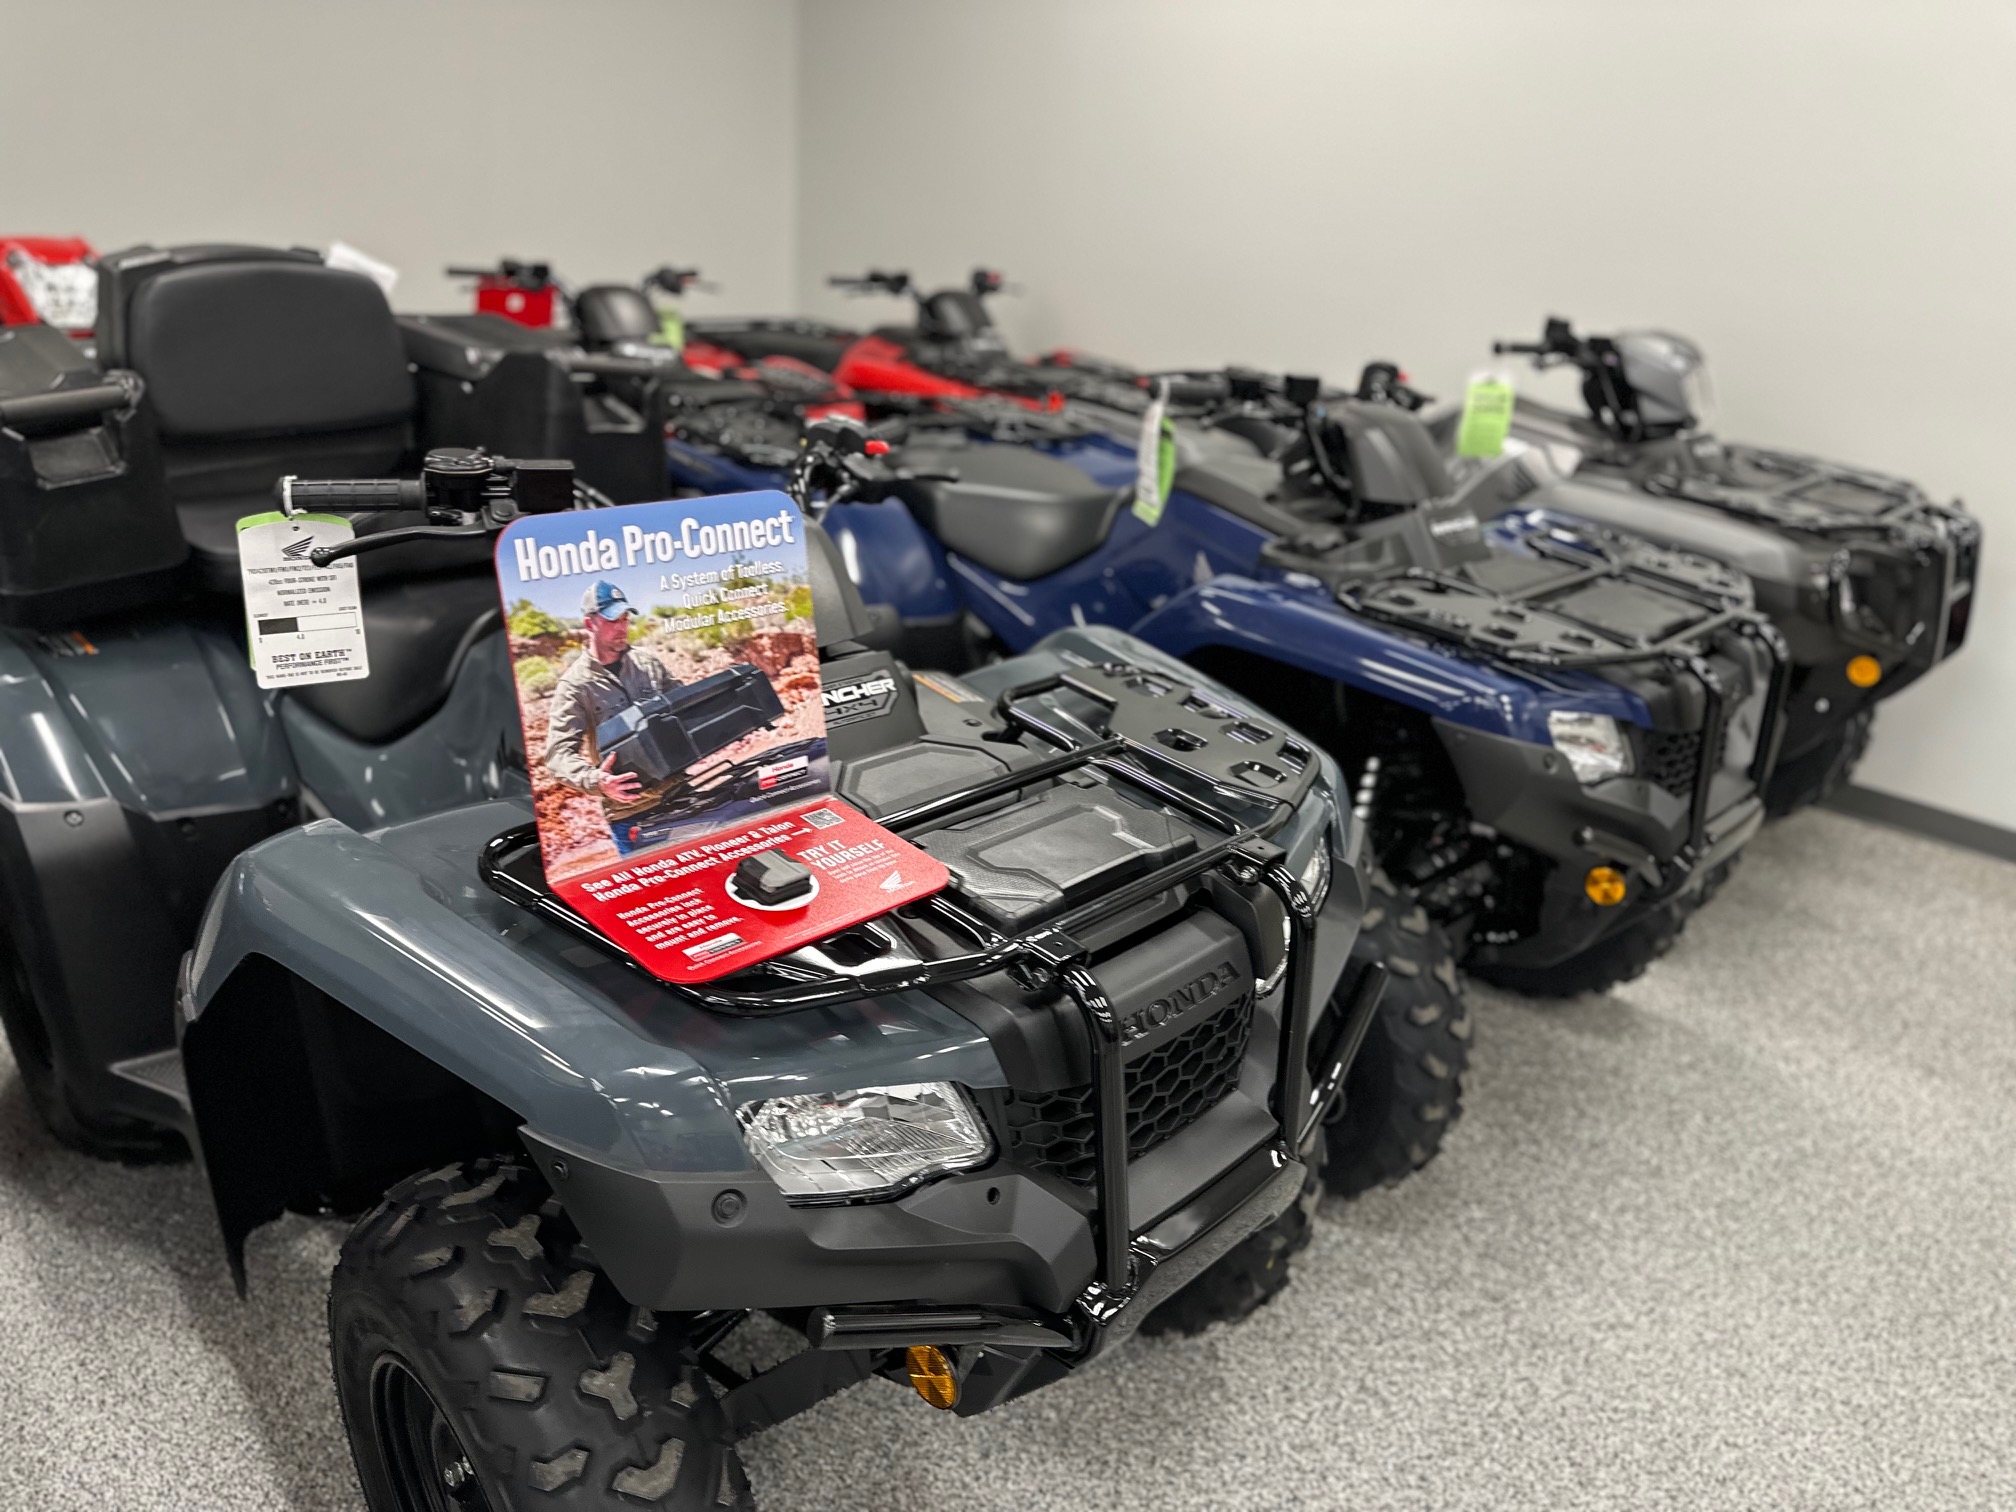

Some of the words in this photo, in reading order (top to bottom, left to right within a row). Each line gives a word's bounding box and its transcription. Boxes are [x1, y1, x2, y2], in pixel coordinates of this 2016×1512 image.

[514, 529, 620, 582] Honda
[660, 575, 669, 591] A
[672, 570, 720, 590] System
[721, 565, 735, 580] of
[683, 590, 719, 609] Quick
[720, 583, 768, 602] Connect
[664, 612, 716, 633] Modular
[717, 601, 789, 624] Accessories.
[272, 653, 296, 664] BEST
[299, 652, 312, 660] ON
[276, 660, 322, 670] PERFORMANCE
[772, 763, 794, 772] Honda
[580, 879, 614, 892] See
[610, 871, 635, 884] All
[630, 858, 680, 877] Honda
[700, 834, 752, 854] Pioneer
[747, 830, 763, 839] &
[758, 821, 796, 835] Talon
[796, 844, 830, 861] TRY
[826, 840, 848, 851] IT
[810, 839, 886, 870] YOURSELF
[592, 882, 643, 902] Honda
[637, 856, 723, 887] Pro-Connect
[718, 834, 792, 861] Accessories
[616, 906, 650, 920] Honda
[647, 887, 705, 909] Pro-Connect
[626, 905, 684, 927] Accessories
[680, 898, 706, 909] lock
[636, 914, 678, 935] securely
[675, 913, 690, 921] in
[687, 905, 715, 918] place
[645, 931, 668, 942] and
[664, 926, 684, 935] are
[681, 918, 707, 930] easy
[654, 933, 688, 950] mount
[686, 927, 708, 939] and
[705, 916, 745, 931] remove.
[1121, 961, 1240, 1046] HONDA
